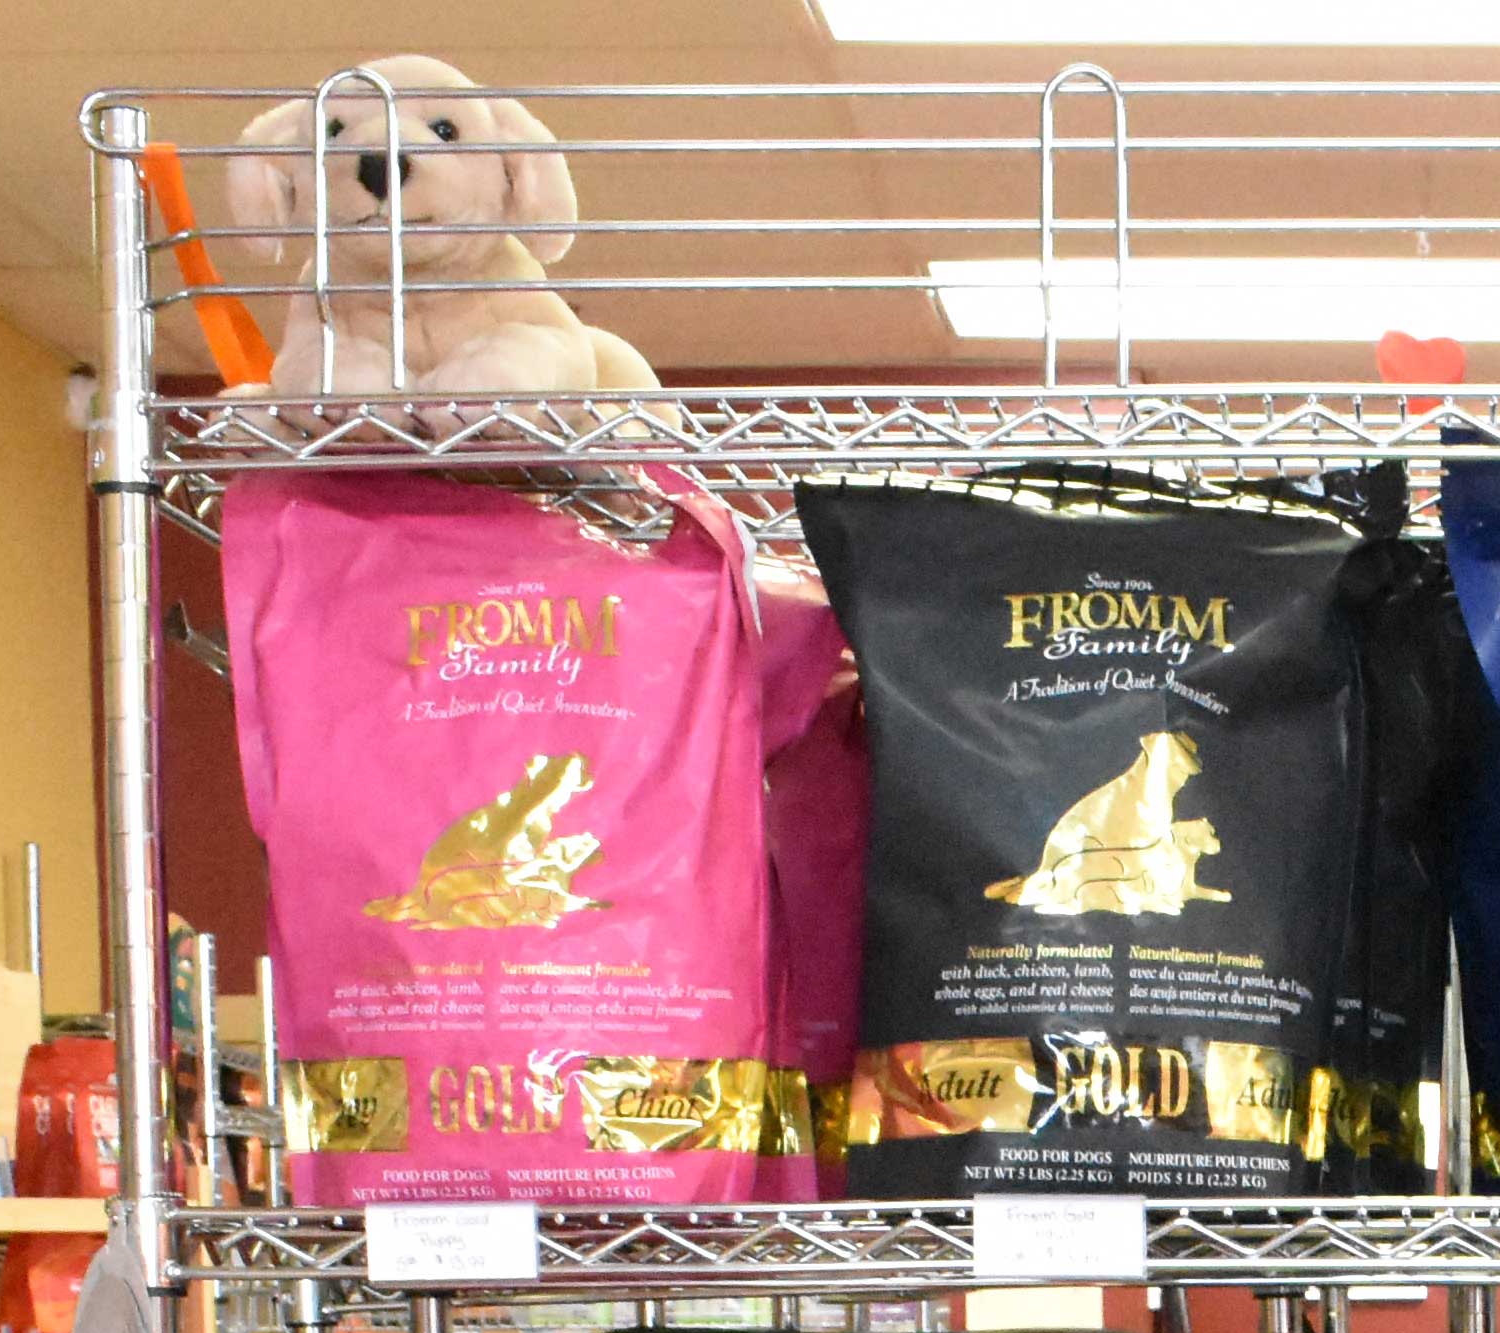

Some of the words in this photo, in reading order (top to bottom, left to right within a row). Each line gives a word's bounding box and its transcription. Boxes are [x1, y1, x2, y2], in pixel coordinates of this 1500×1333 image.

[405, 595, 623, 665] FROMM
[1003, 591, 1234, 650] FROMM
[439, 641, 582, 686] Family
[1043, 629, 1194, 665] Family
[1001, 680, 1021, 704] A
[1022, 673, 1091, 701] Tradition
[1094, 668, 1111, 695] of
[1113, 668, 1155, 690] Quiet
[967, 943, 1032, 961] Naturally
[1035, 943, 1113, 960] formulated
[917, 1069, 1003, 1105] Adult
[1055, 1044, 1189, 1118] GOLD
[999, 1148, 1039, 1164] FOOD
[1043, 1149, 1070, 1164] FOR
[1074, 1150, 1112, 1165] DOGS
[1128, 1153, 1213, 1169] NOURRITURE
[1214, 1154, 1246, 1169] POUR
[1249, 1156, 1290, 1172] CHIENS
[964, 1166, 991, 1180] NET
[994, 1166, 1015, 1180] WT
[1018, 1167, 1026, 1180] 5
[1029, 1166, 1053, 1181] LBS
[1087, 1167, 1113, 1184] KG)
